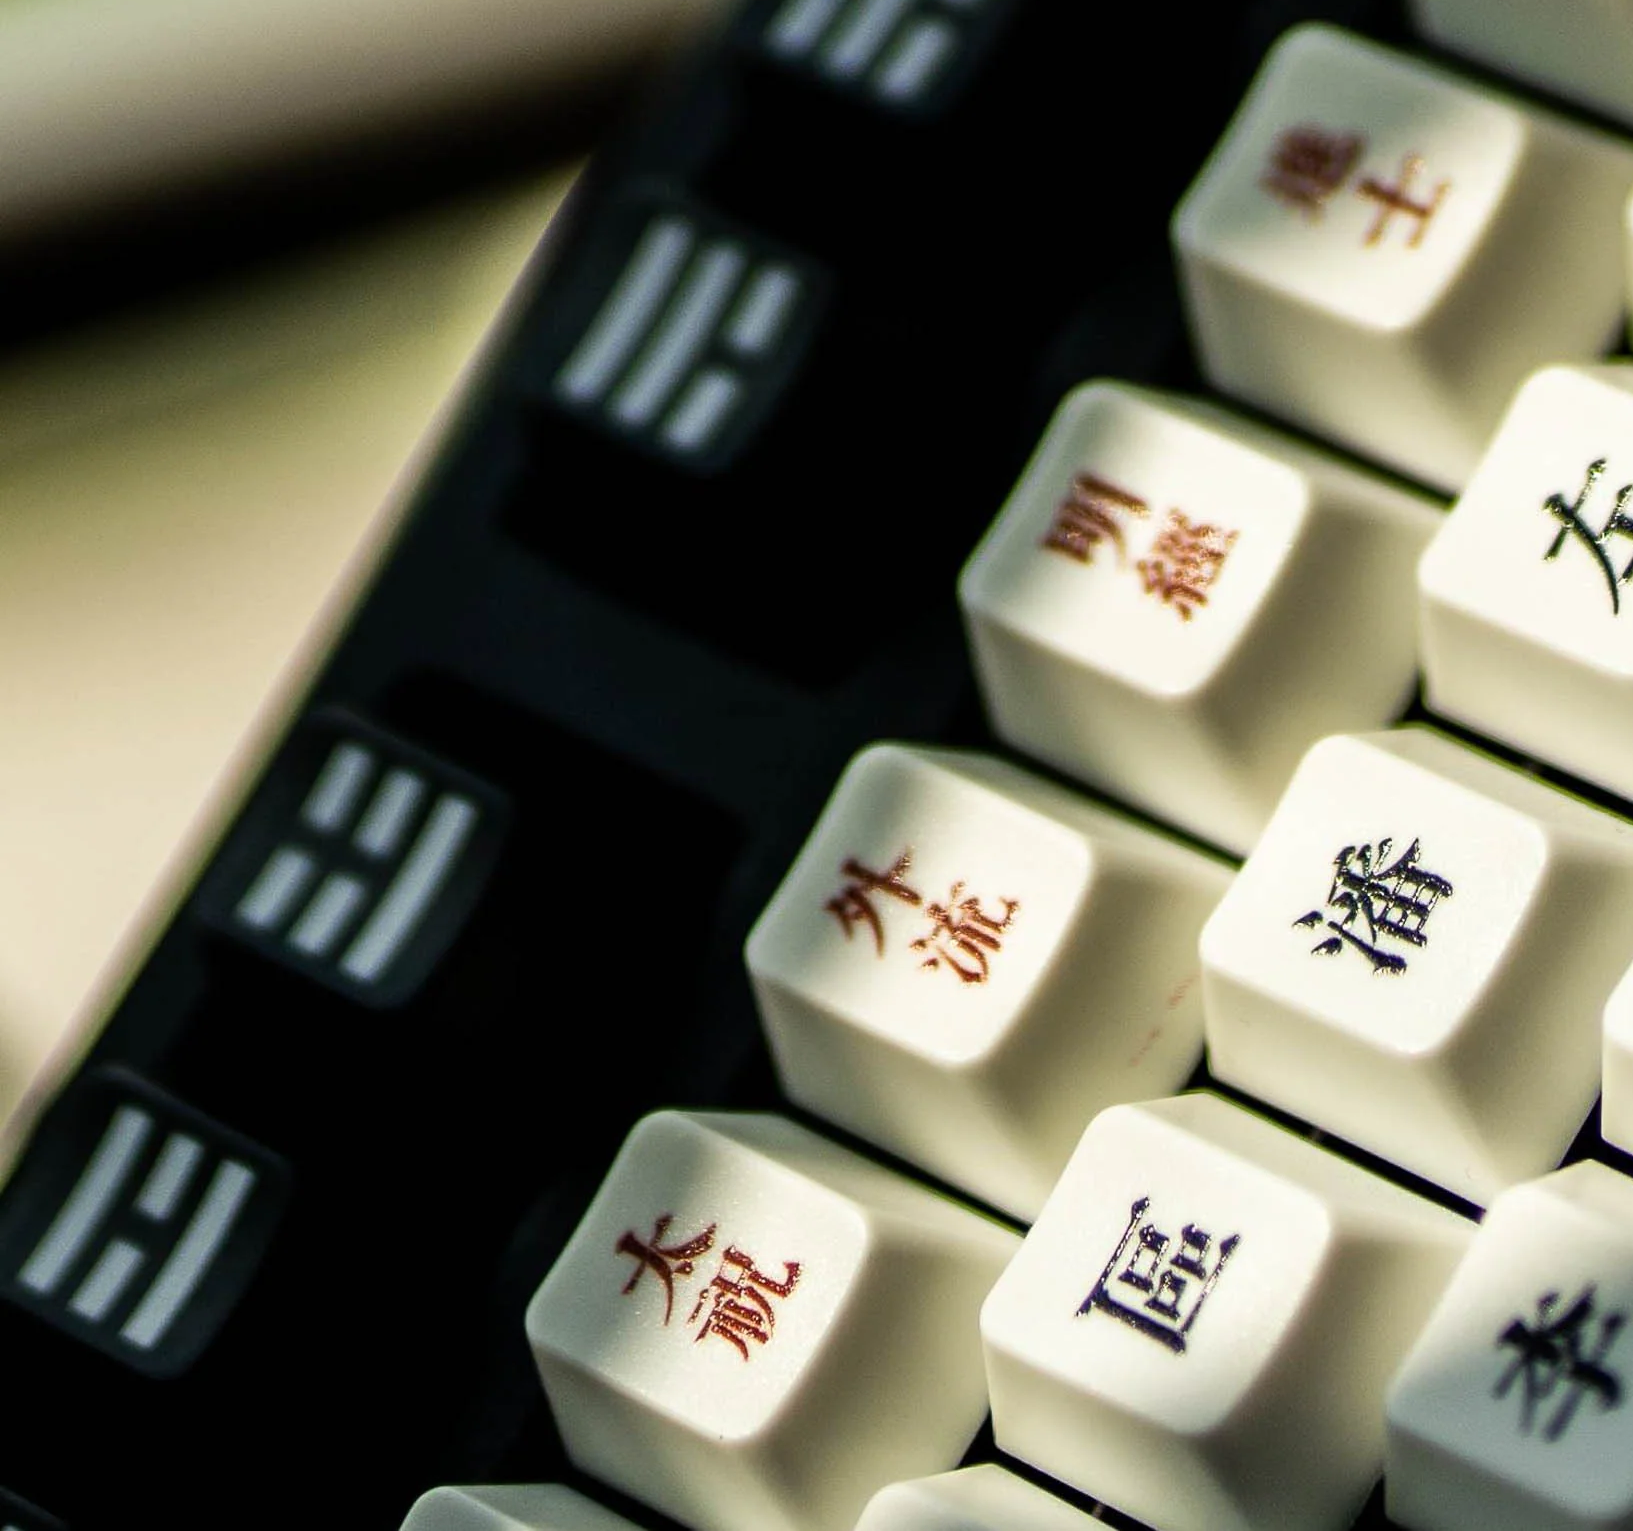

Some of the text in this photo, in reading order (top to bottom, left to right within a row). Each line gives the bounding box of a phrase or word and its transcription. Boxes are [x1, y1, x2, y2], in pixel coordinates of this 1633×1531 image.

[1042, 471, 1236, 621] 明經
[826, 845, 1020, 985] 外流
[1295, 838, 1452, 974] 潘
[615, 1211, 802, 1361] 太祝
[1078, 1198, 1239, 1355] 區
[1494, 1290, 1629, 1441] 李
